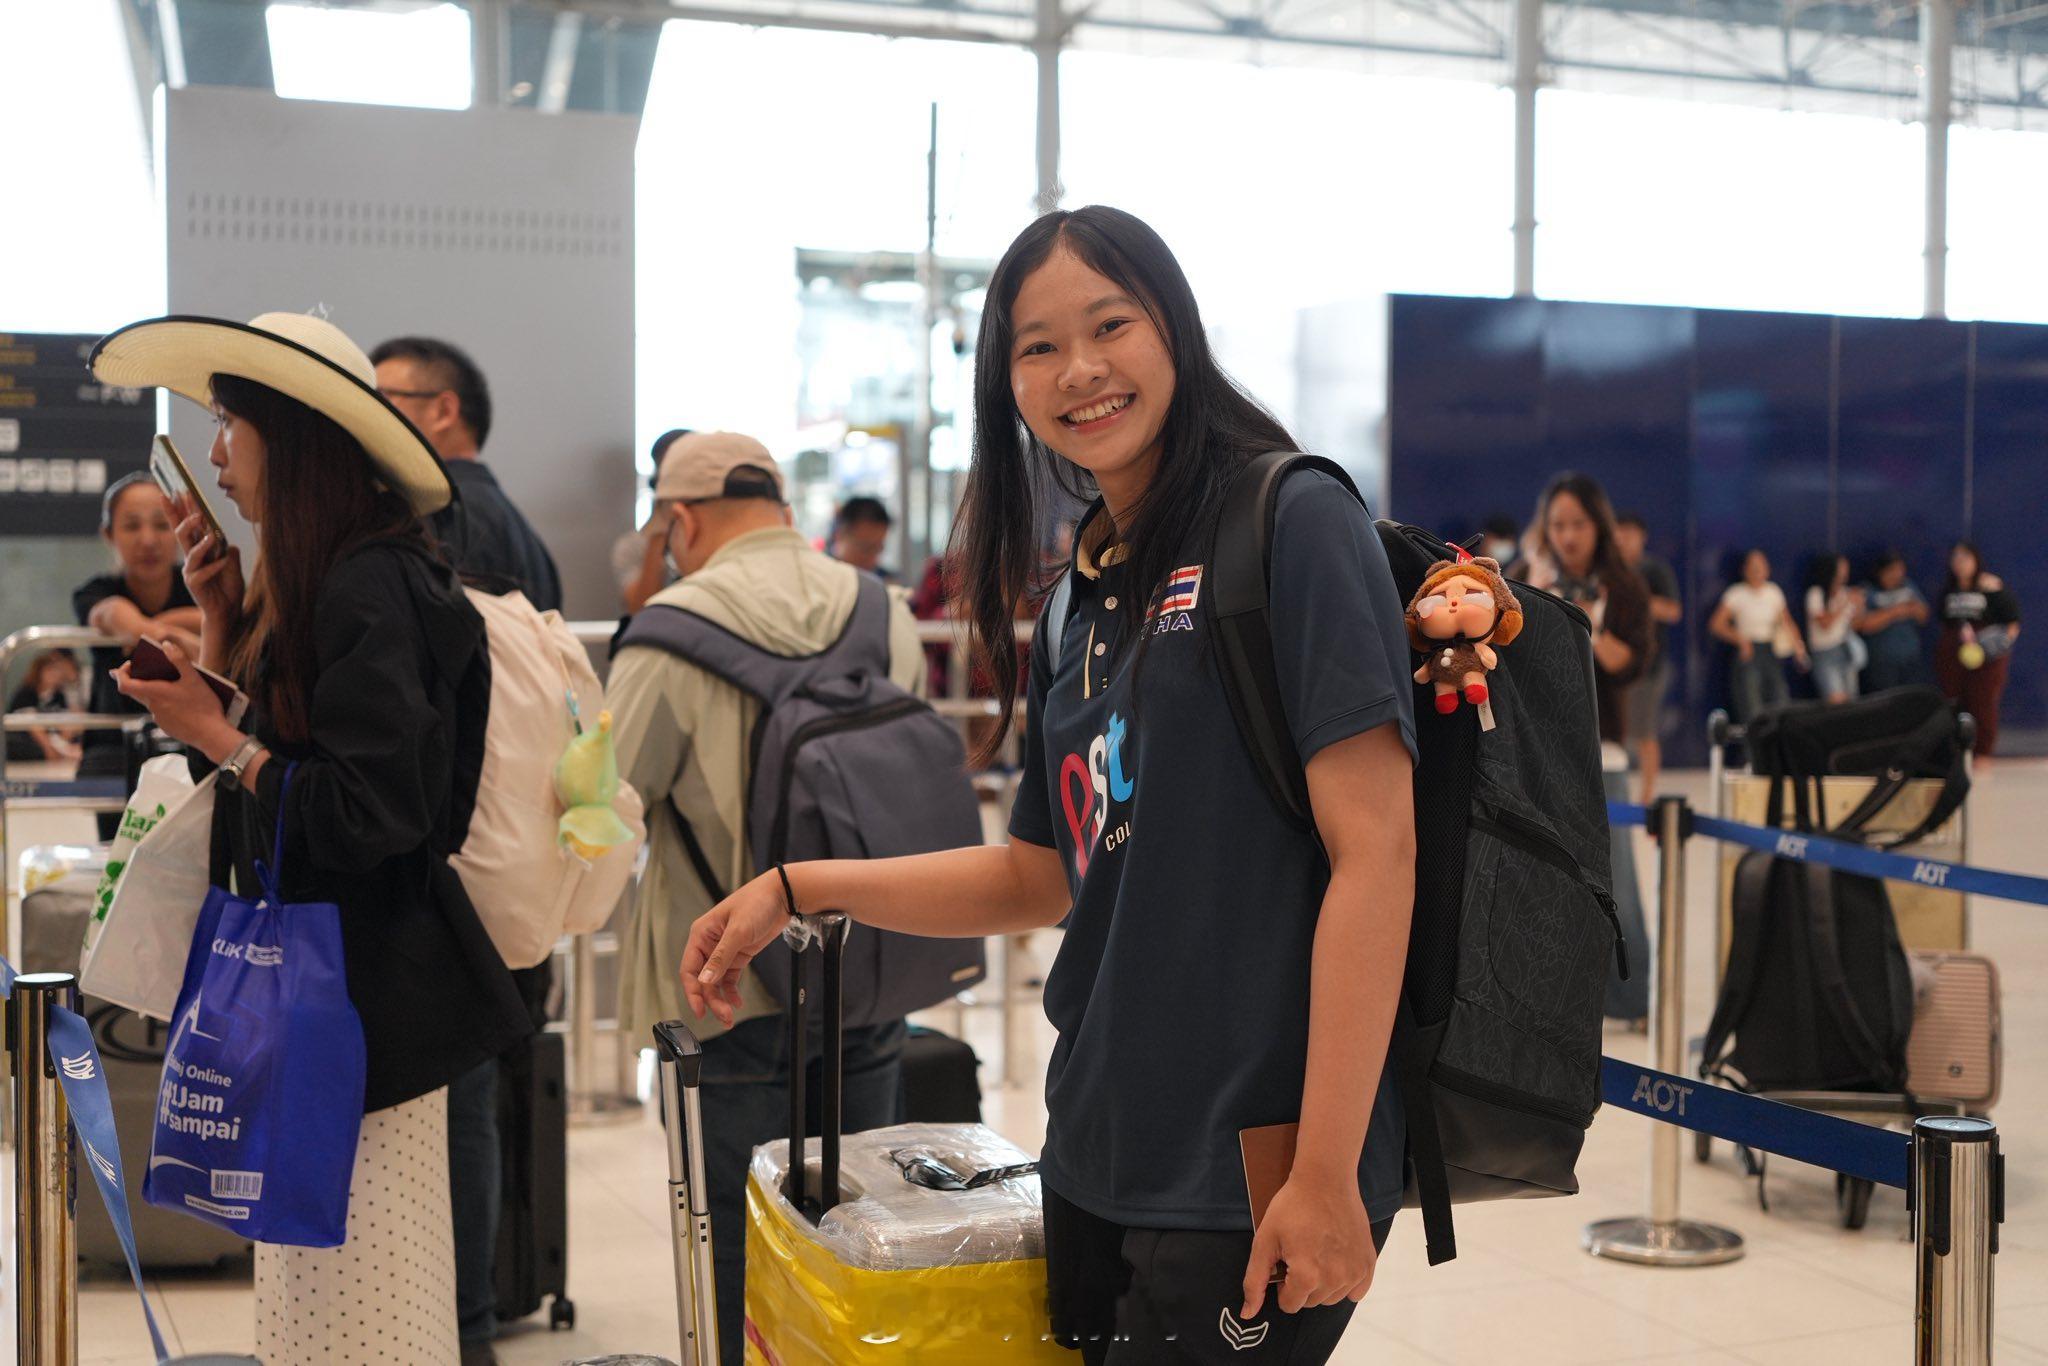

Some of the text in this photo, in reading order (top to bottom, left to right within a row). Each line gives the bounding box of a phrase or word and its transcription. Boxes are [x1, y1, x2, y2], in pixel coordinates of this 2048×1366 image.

[1912, 860, 1950, 886] AOT
[186, 1064, 232, 1088] Online
[162, 1079, 224, 1114] #1Jam
[1631, 1074, 1694, 1116] AOT
[159, 1101, 242, 1141] #sampai
